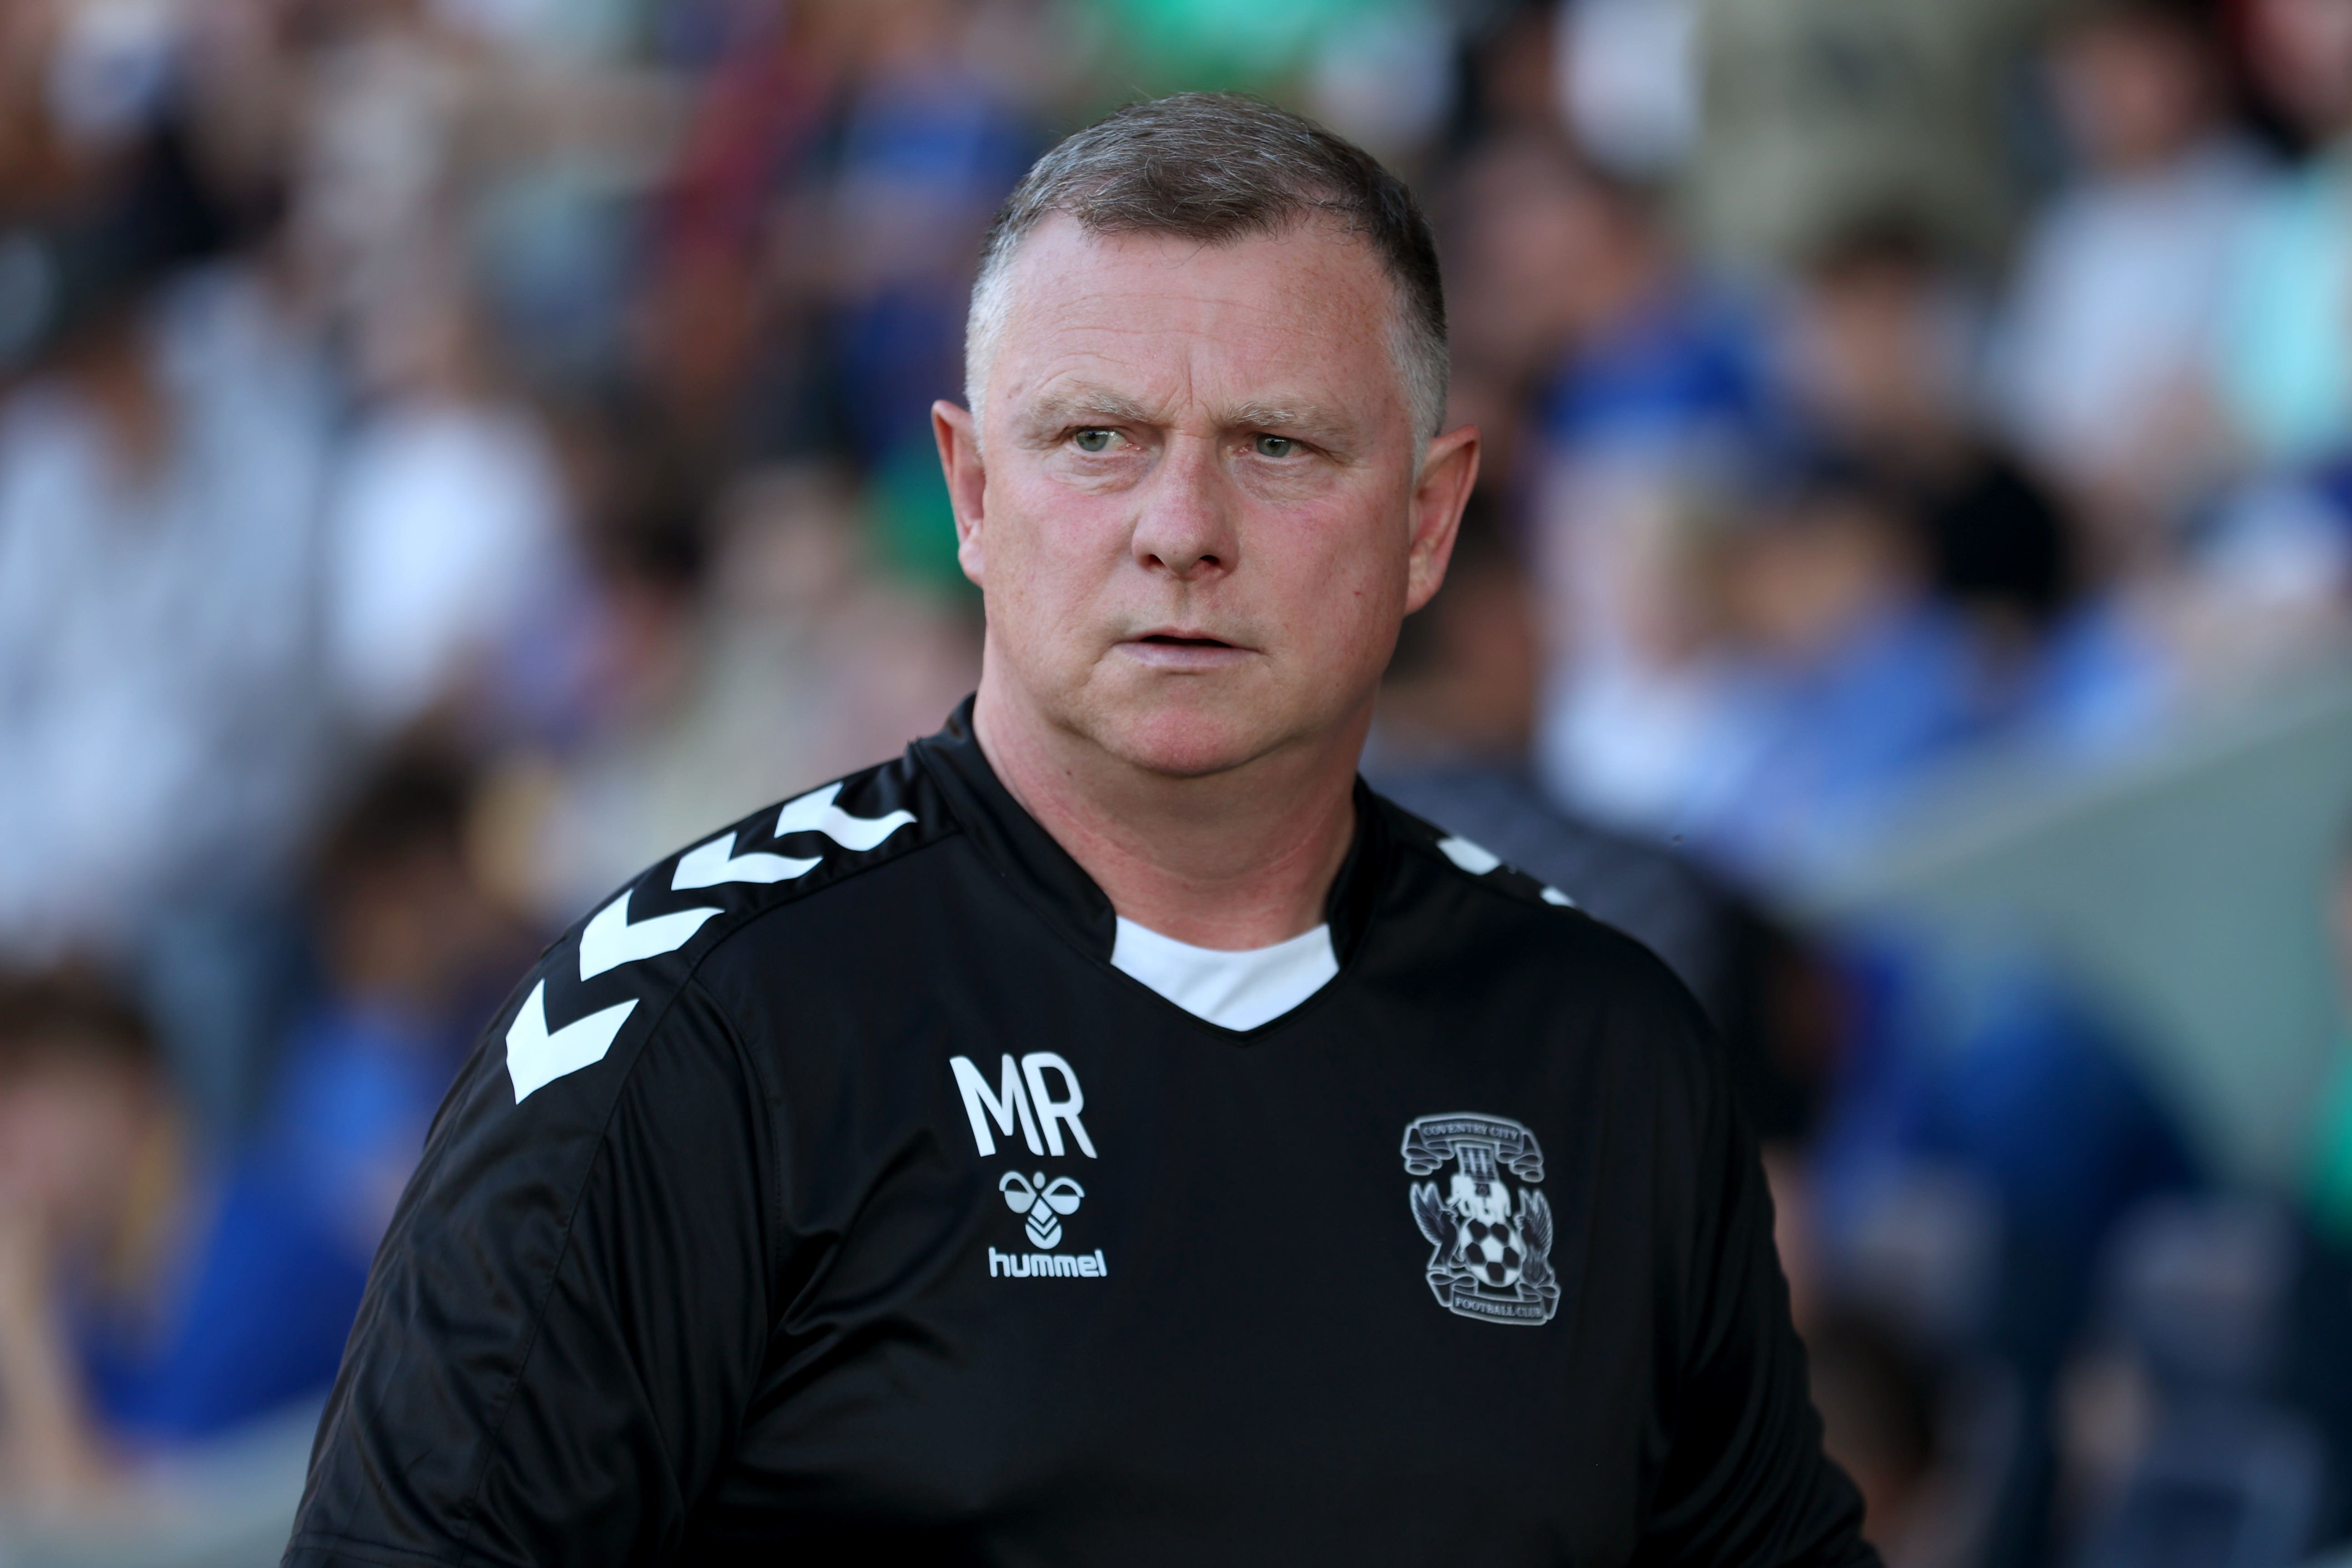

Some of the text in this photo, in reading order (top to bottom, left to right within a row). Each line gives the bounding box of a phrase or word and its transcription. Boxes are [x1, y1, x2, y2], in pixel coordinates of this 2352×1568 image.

[949, 1051, 1098, 1159] MR
[1423, 1122, 1518, 1140] COVENTRY CITY
[988, 1246, 1107, 1277] hummel
[1454, 1297, 1542, 1317] FOOTBALL CLUB
